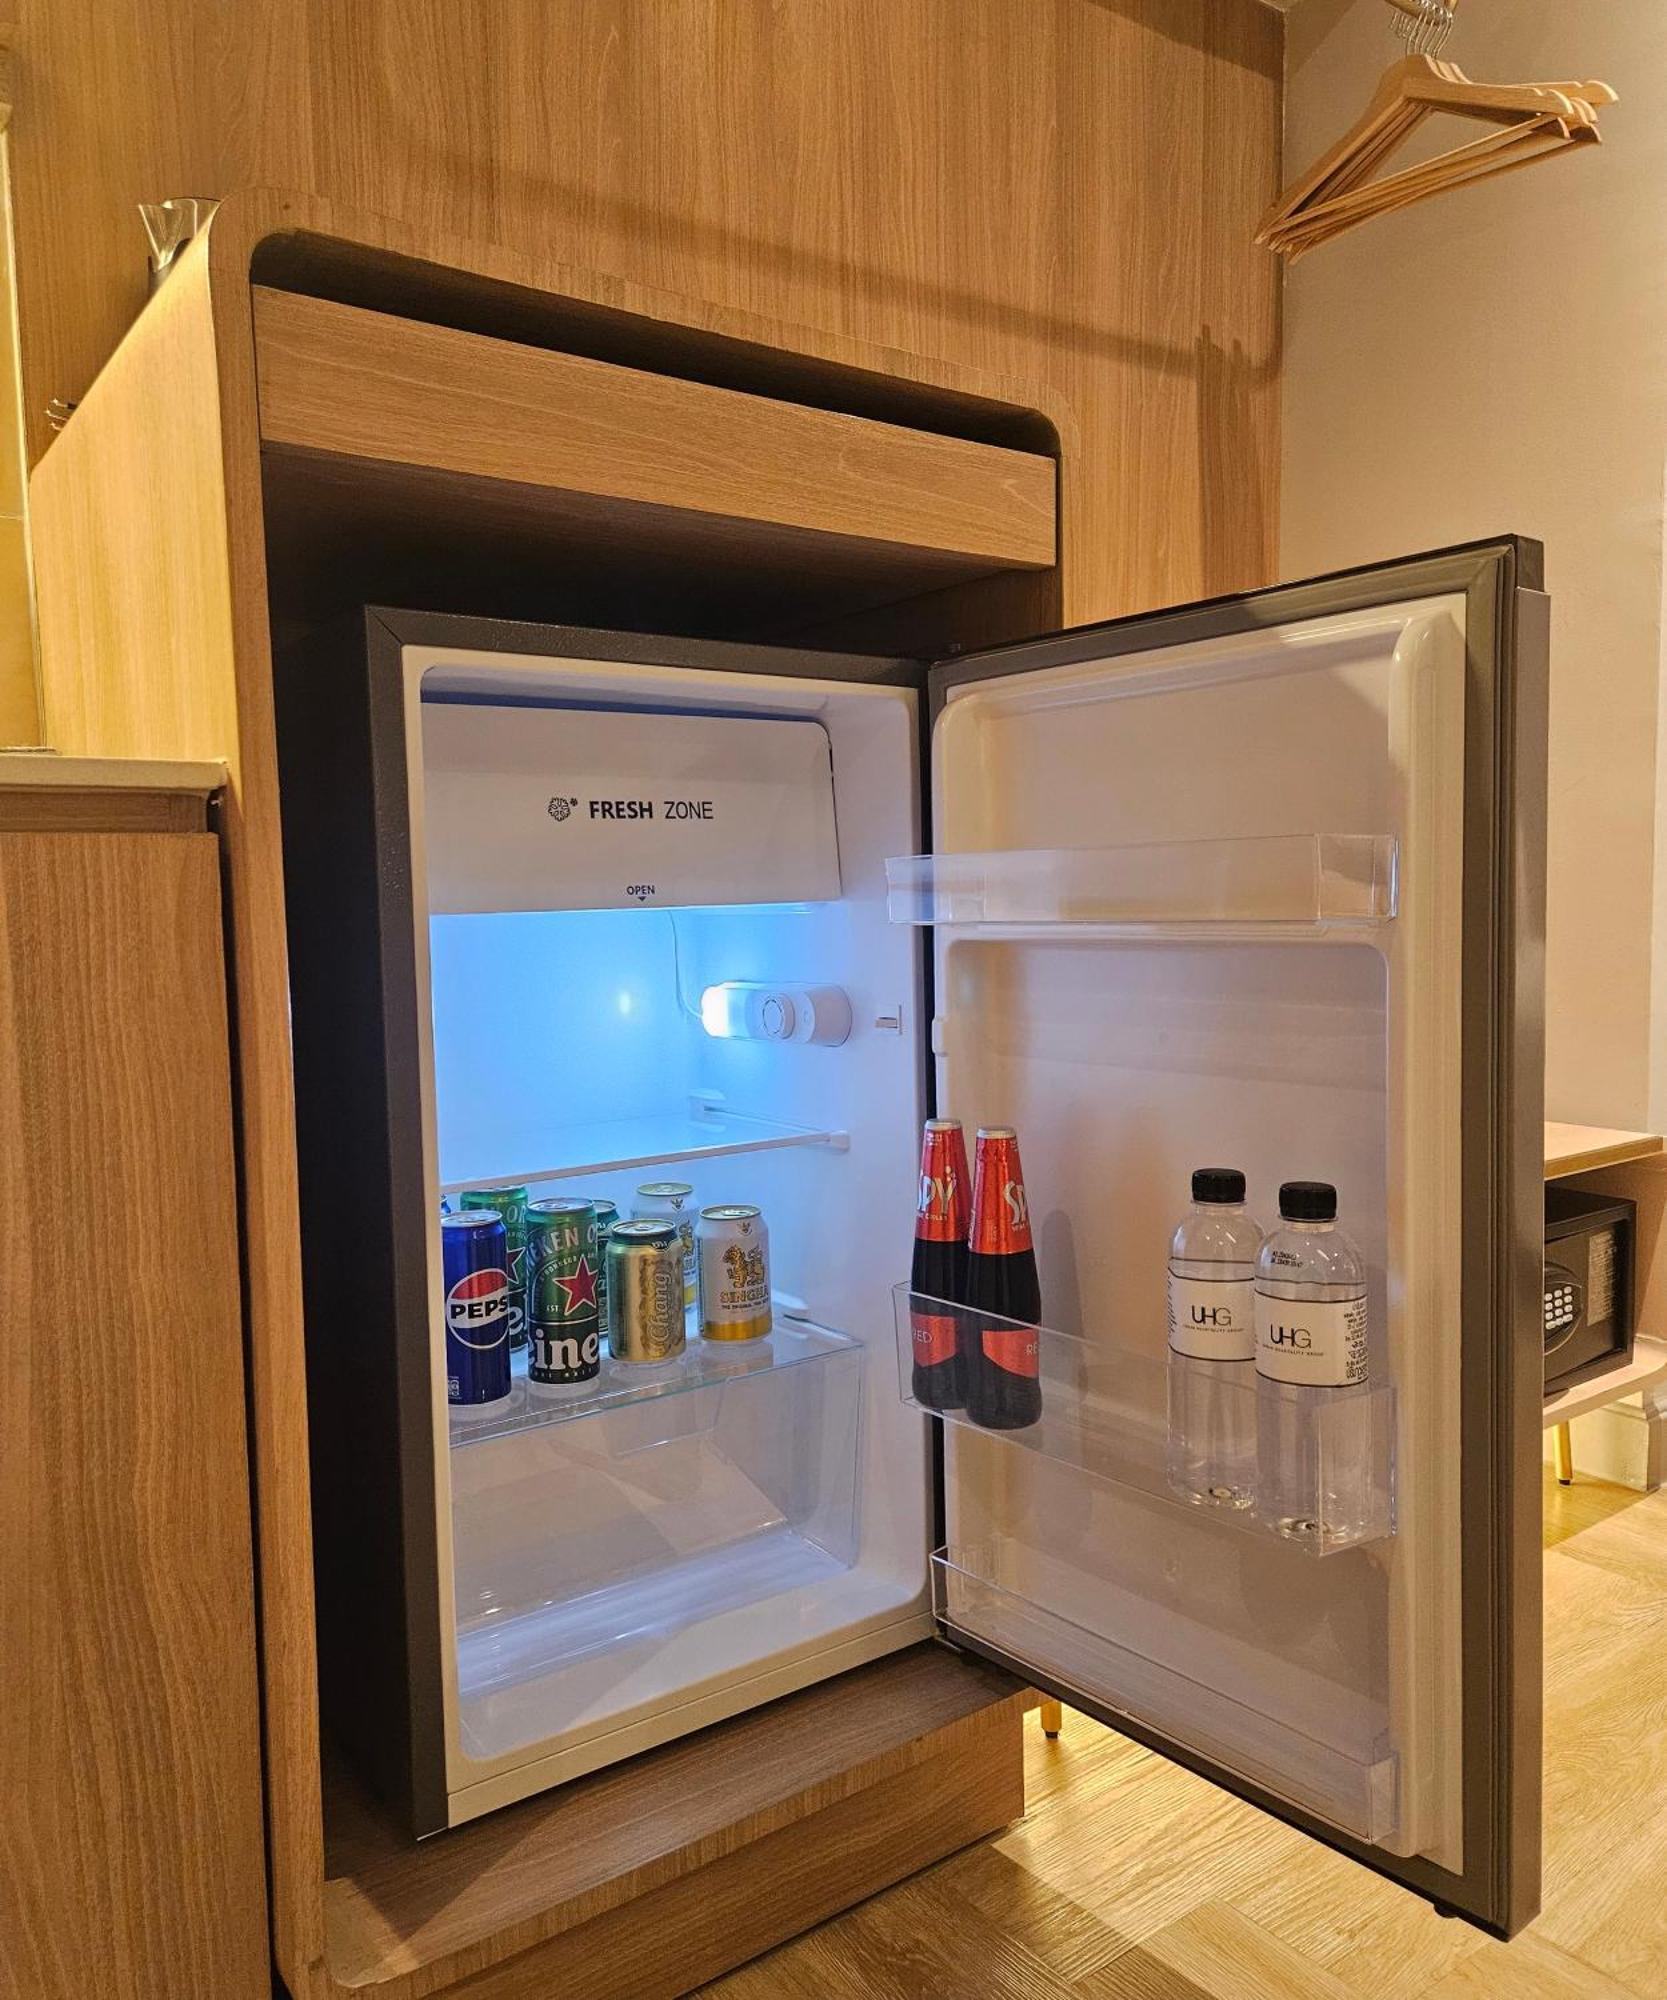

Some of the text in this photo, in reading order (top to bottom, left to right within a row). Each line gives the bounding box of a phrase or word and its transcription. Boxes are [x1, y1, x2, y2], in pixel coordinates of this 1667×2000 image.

[589, 801, 714, 820] FRESH ZONE
[626, 885, 656, 896] OPEN
[647, 1272, 672, 1341] Chang
[1191, 1304, 1232, 1326] UHG
[1270, 1323, 1312, 1349] UHG
